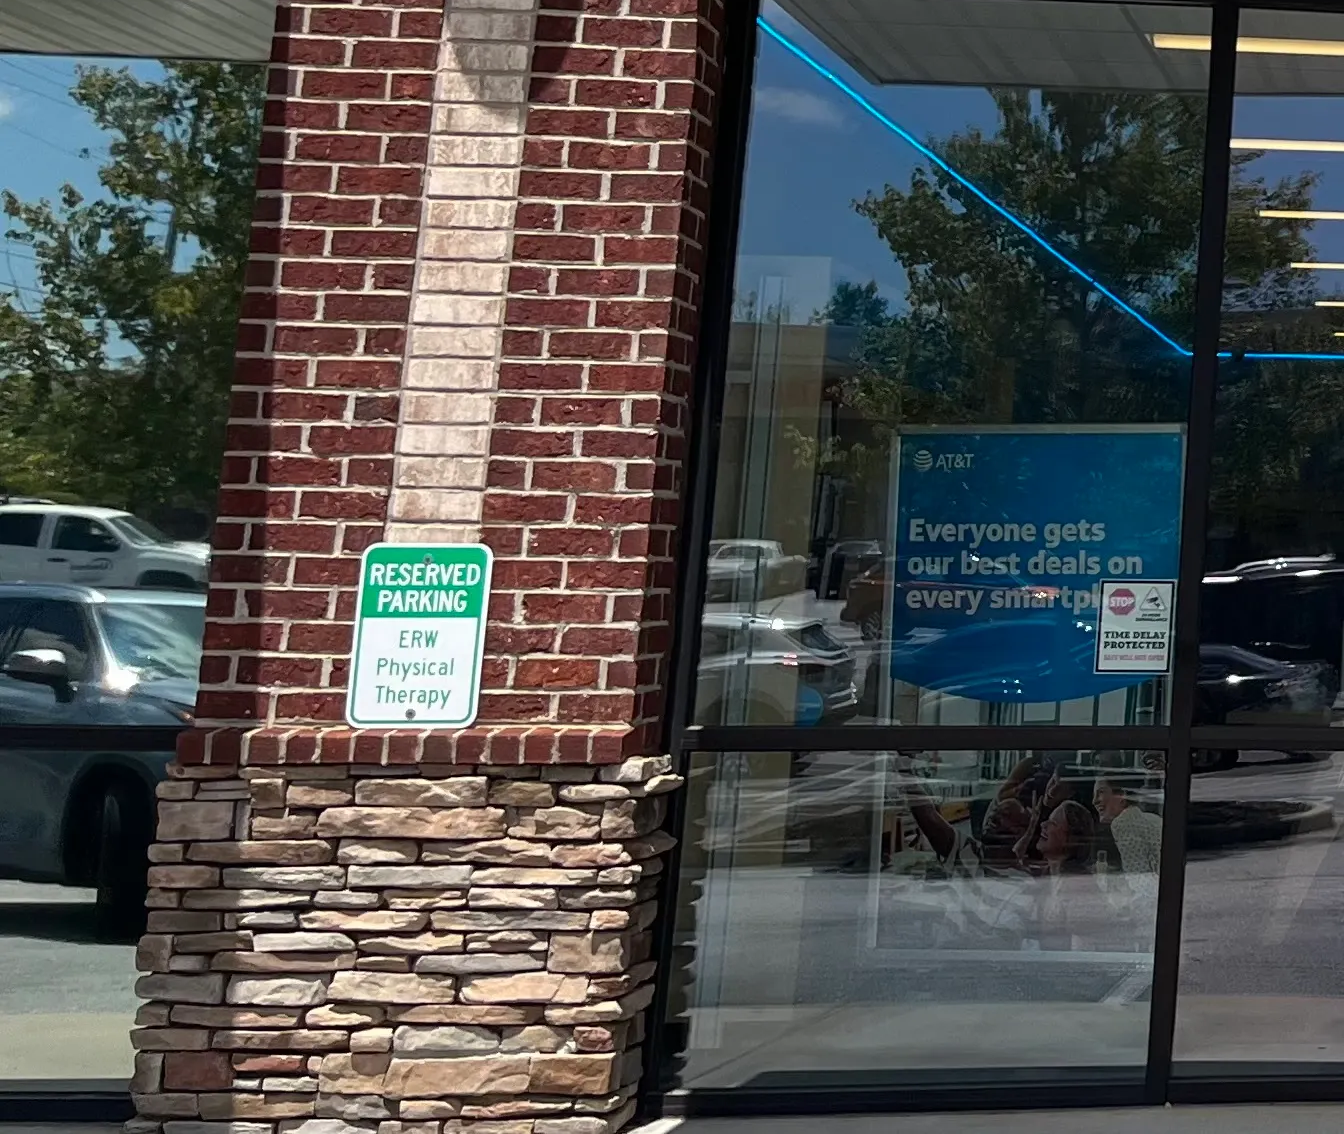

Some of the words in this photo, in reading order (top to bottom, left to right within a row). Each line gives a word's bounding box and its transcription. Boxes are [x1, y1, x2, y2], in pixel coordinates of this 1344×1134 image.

[936, 453, 975, 469] AT&T
[909, 518, 1037, 548] Everyone
[1044, 519, 1106, 548] gets
[369, 563, 481, 586] RESERVED
[907, 554, 954, 575] our
[960, 551, 1021, 575] best
[1027, 551, 1101, 575] deals
[1107, 555, 1143, 575] on
[377, 589, 468, 613] PARKING
[906, 587, 983, 615] every
[1110, 597, 1135, 607] STOP
[399, 630, 439, 648] ERW
[1104, 631, 1130, 639] TIME
[1132, 631, 1166, 639] DELAY
[1104, 641, 1166, 649] PROTECTED
[376, 657, 455, 682] Physical
[375, 685, 452, 709] Therapy
